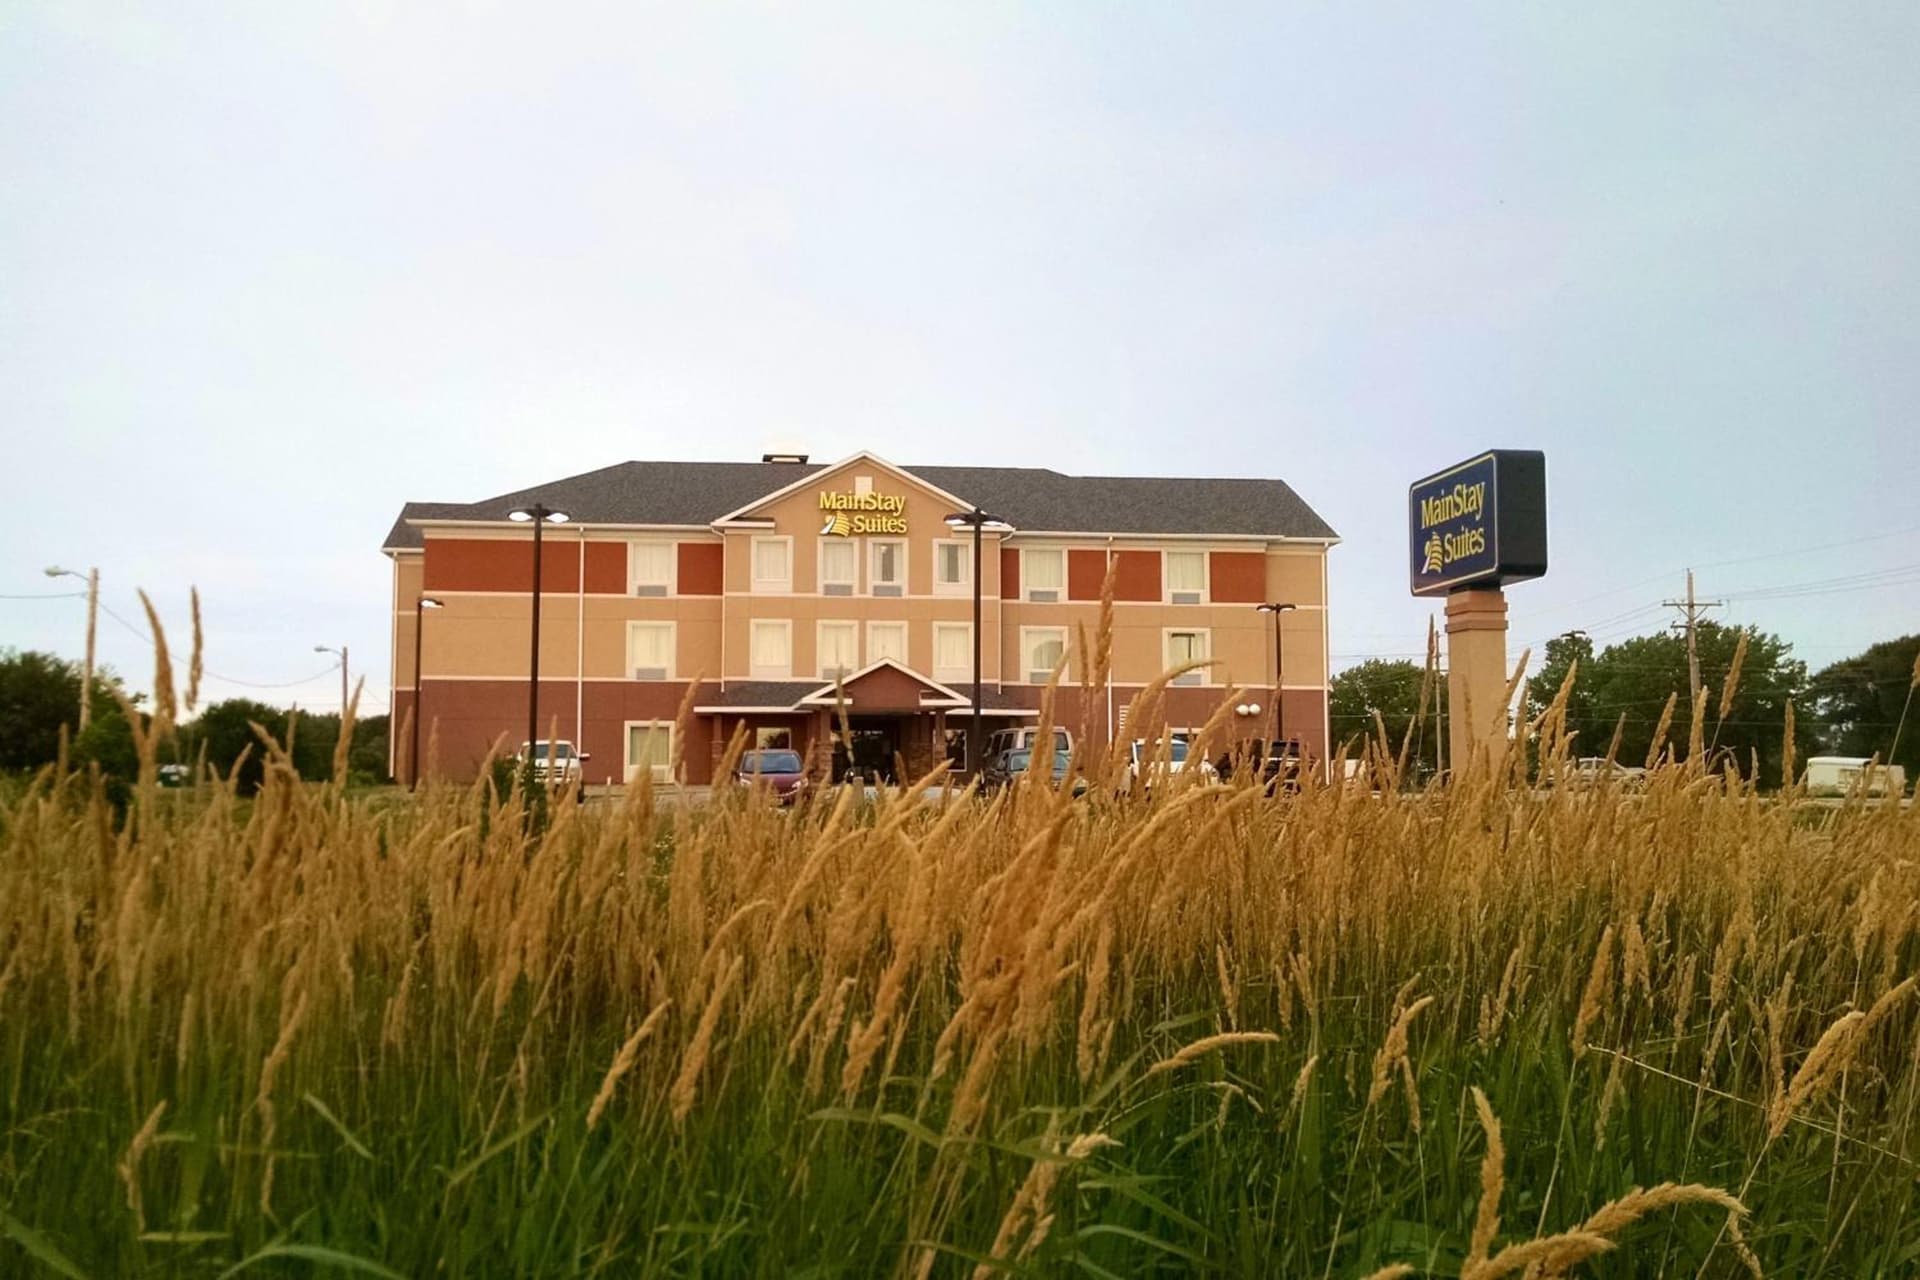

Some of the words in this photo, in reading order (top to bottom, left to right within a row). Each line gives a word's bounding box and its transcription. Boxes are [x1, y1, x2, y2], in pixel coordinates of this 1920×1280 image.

[820, 491, 905, 516] MainStay
[1421, 482, 1485, 529] MainStay
[854, 514, 907, 533] Suites
[1444, 526, 1485, 563] Suites
